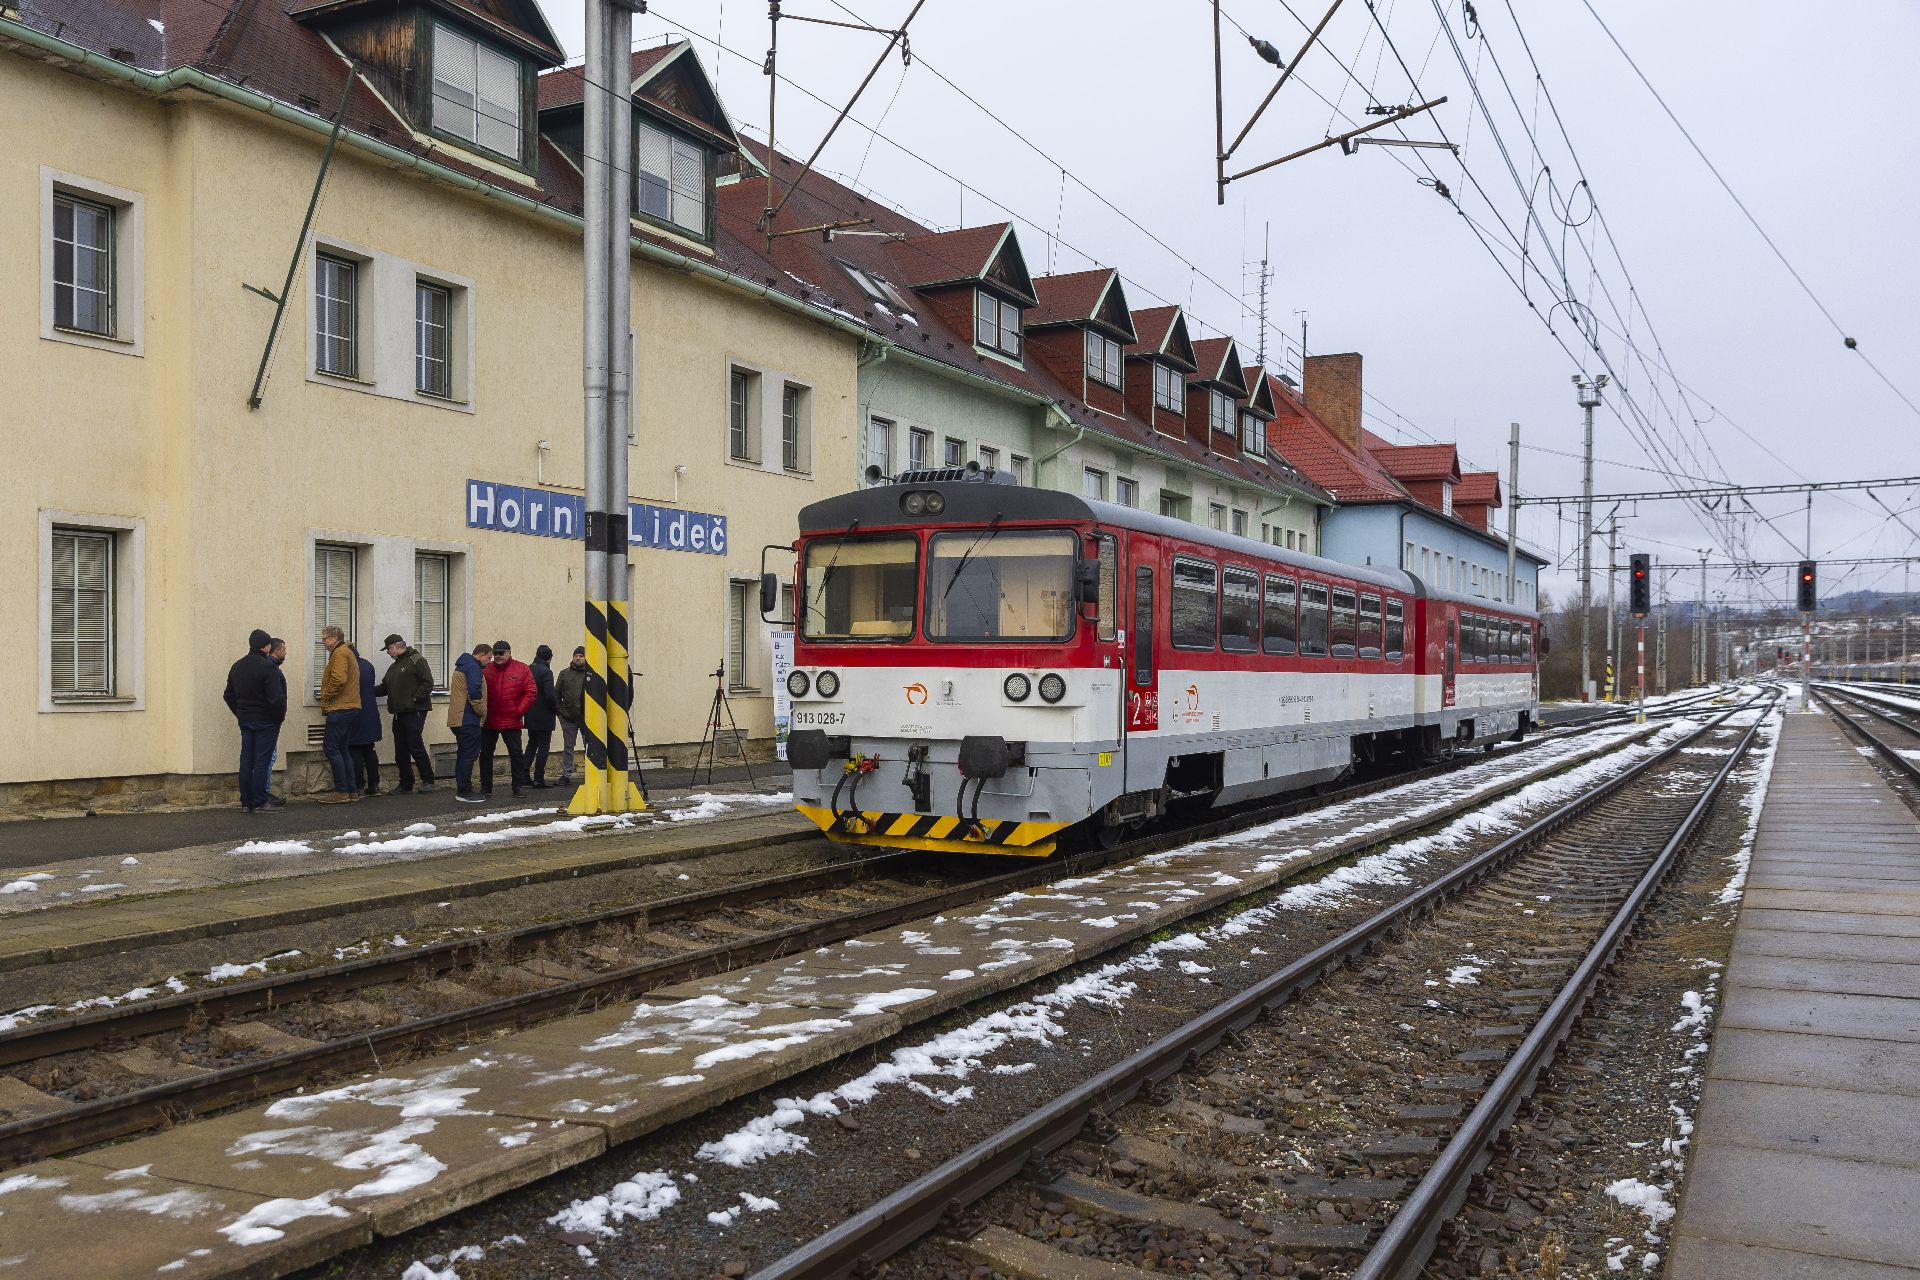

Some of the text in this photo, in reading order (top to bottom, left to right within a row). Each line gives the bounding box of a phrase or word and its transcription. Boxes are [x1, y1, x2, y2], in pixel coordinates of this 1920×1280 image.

[470, 484, 725, 552] Horn Lideč
[796, 712, 846, 725] 913 028-7
[1132, 692, 1141, 726] 2
